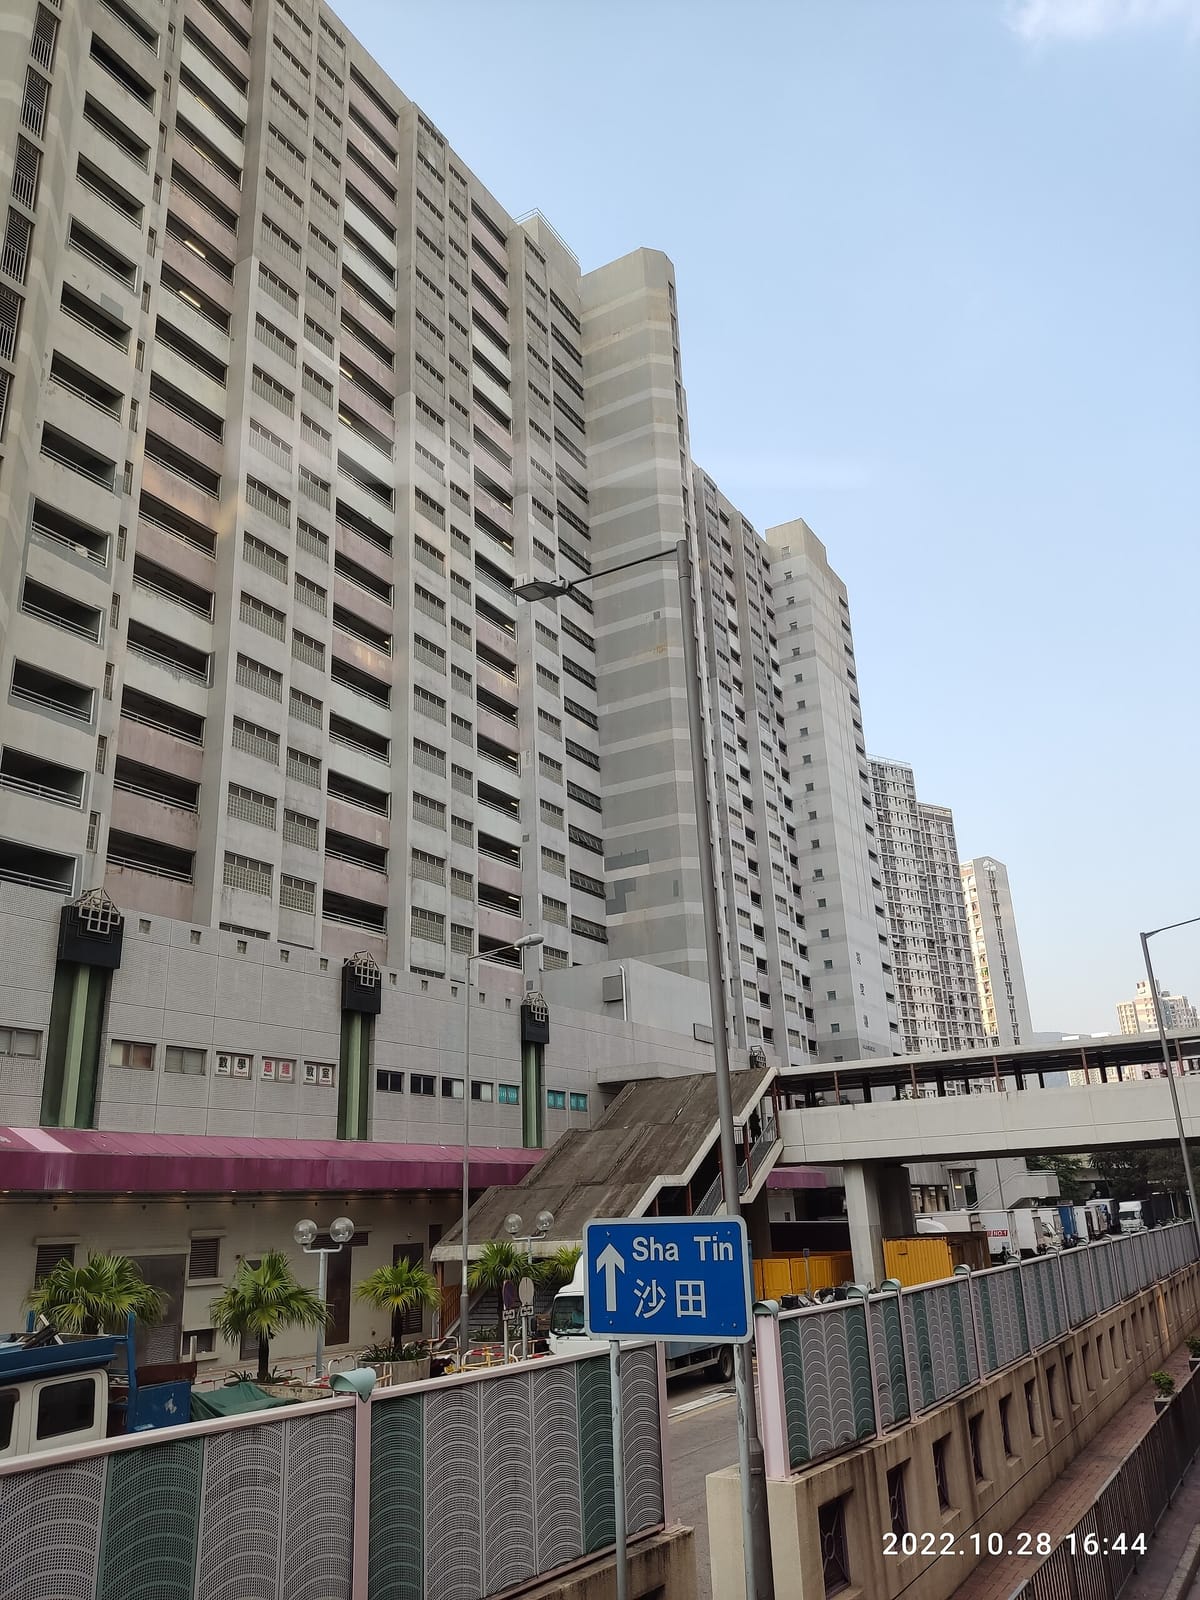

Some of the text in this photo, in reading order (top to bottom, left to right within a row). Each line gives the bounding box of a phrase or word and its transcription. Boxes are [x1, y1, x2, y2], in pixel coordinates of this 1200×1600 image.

[632, 1235, 733, 1261] Sha Tin
[633, 1279, 706, 1319] 沙田
